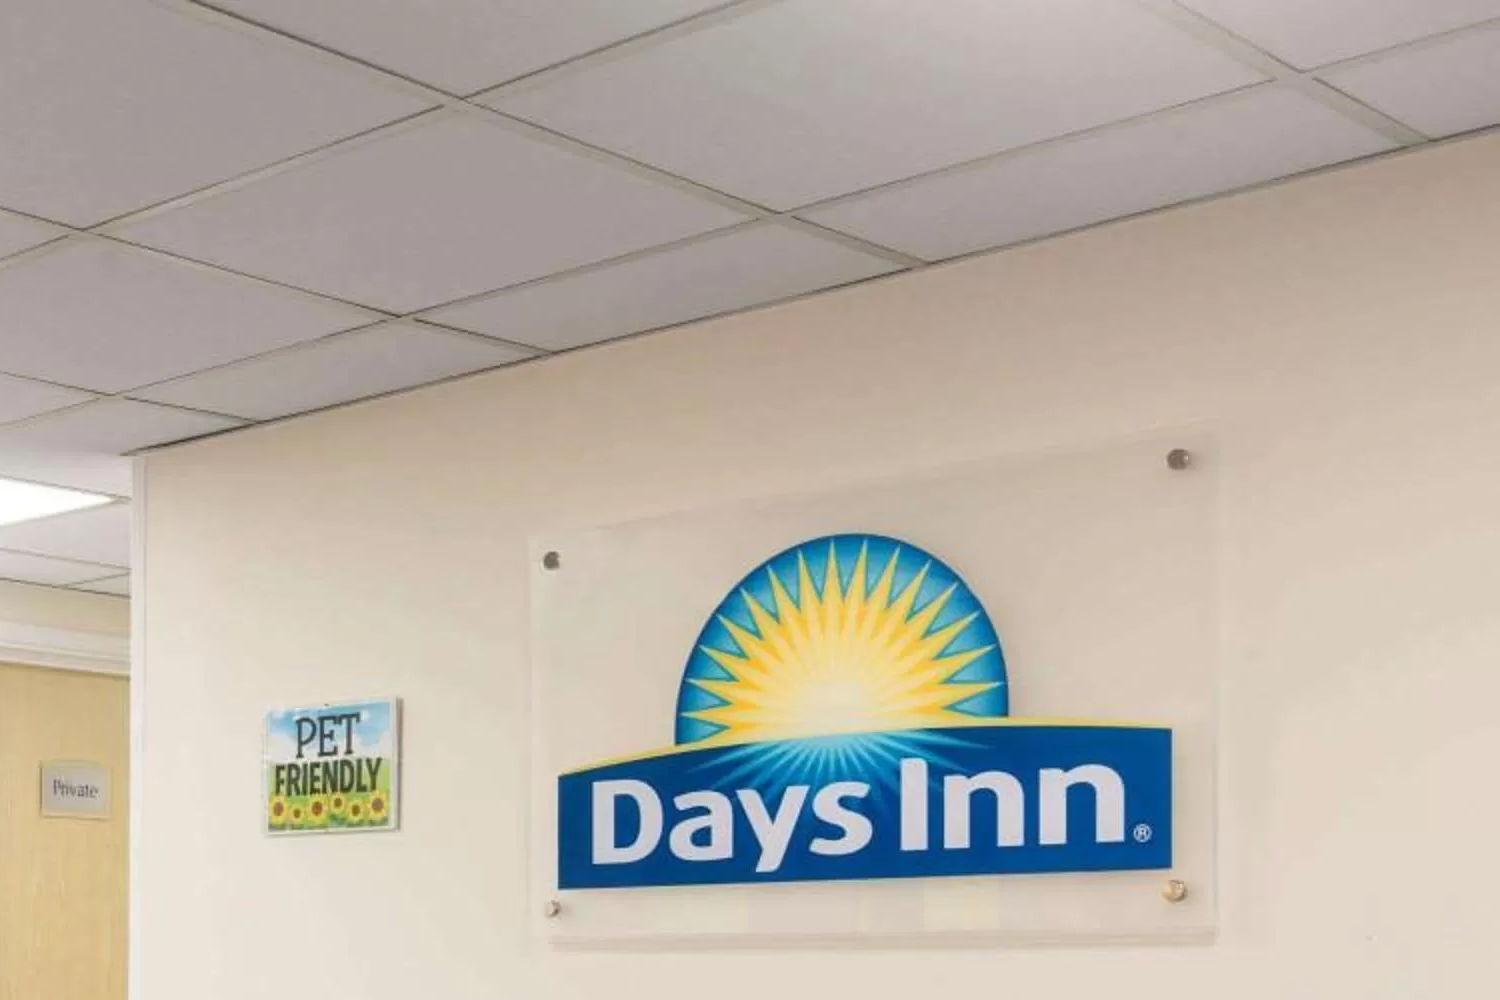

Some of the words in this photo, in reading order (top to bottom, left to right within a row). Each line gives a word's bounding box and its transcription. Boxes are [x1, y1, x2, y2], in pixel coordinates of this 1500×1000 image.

[295, 711, 361, 759] PET
[52, 778, 100, 799] Private
[274, 756, 384, 797] FRIENDLY
[592, 778, 874, 873] Days
[899, 757, 1126, 852] Inn
